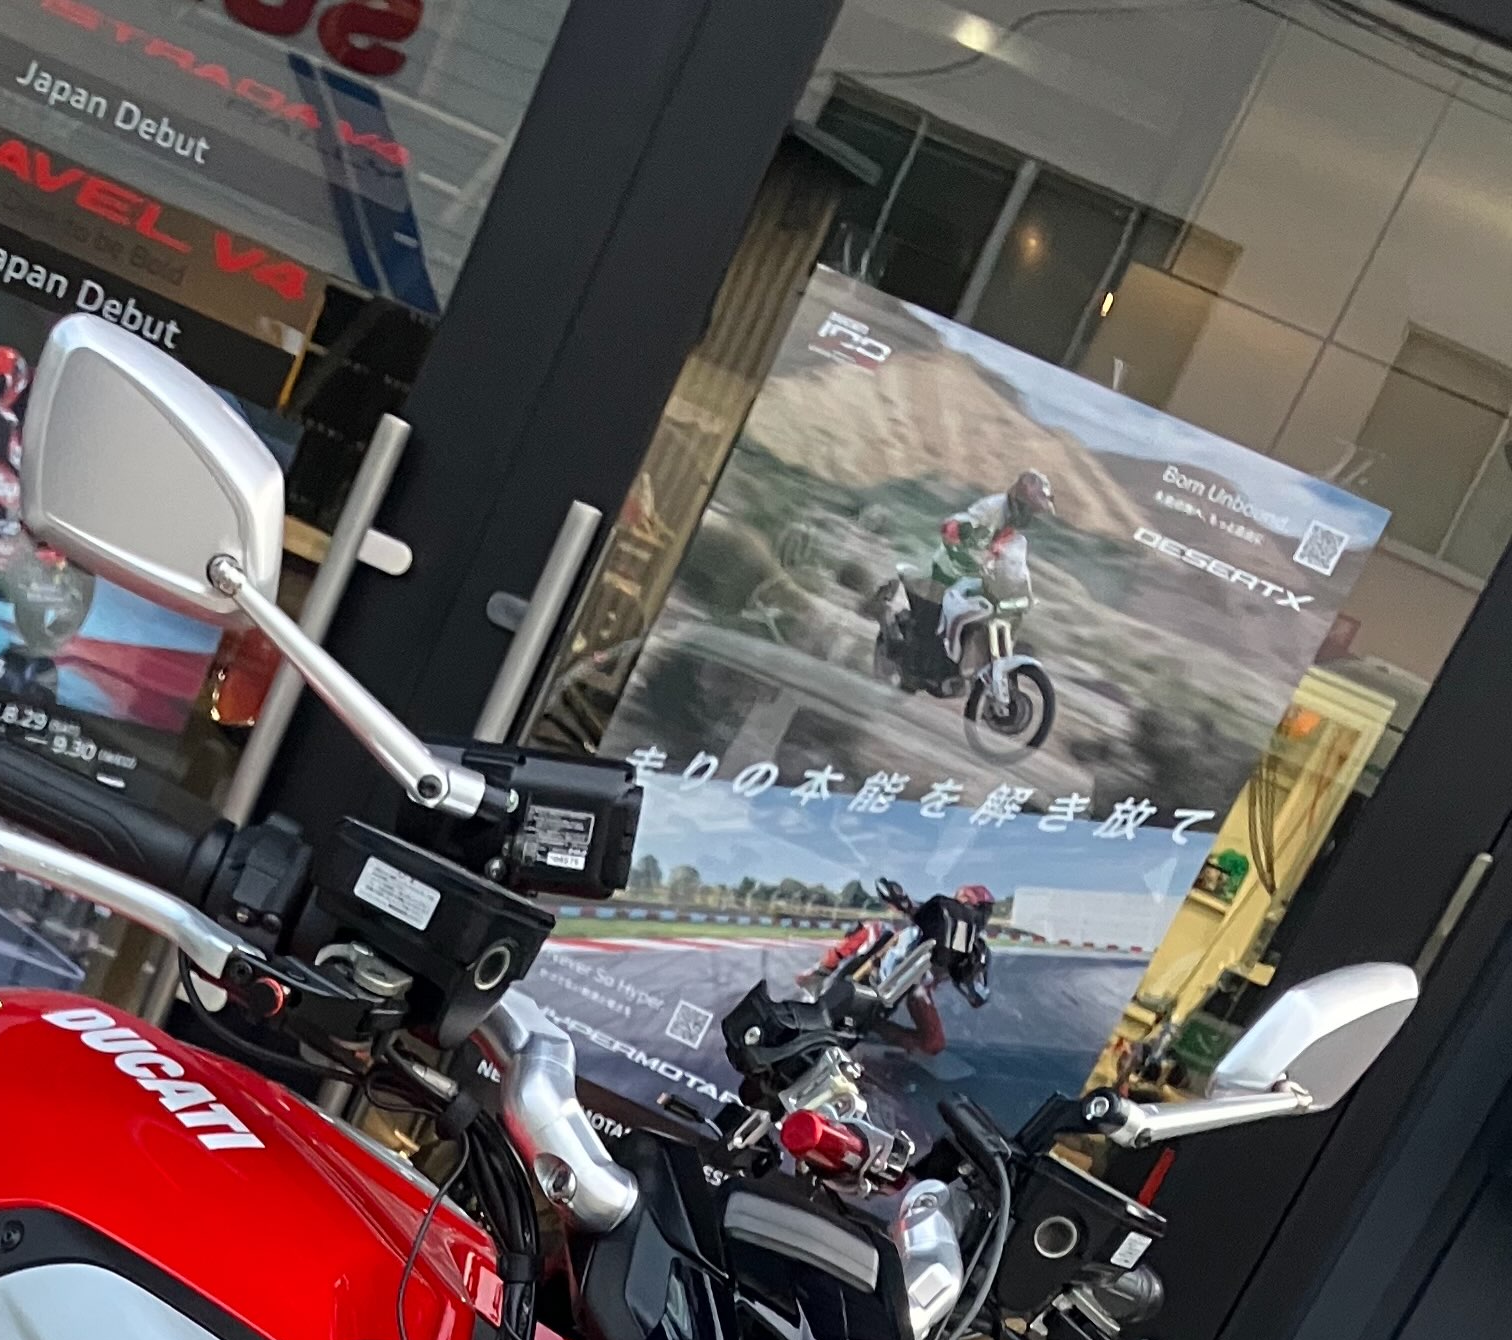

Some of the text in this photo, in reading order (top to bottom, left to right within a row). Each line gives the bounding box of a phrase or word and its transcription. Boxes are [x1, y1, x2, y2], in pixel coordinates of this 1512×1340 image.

[16, 60, 107, 120] Japan
[112, 100, 212, 165] Debut
[214, 230, 309, 302] V4
[76, 278, 182, 349] Debut
[1163, 464, 1206, 496] Born
[1134, 527, 1316, 612] DESERTX
[594, 965, 615, 988] So
[617, 978, 665, 1012] Hyper
[40, 1008, 266, 1151] DUCATI
